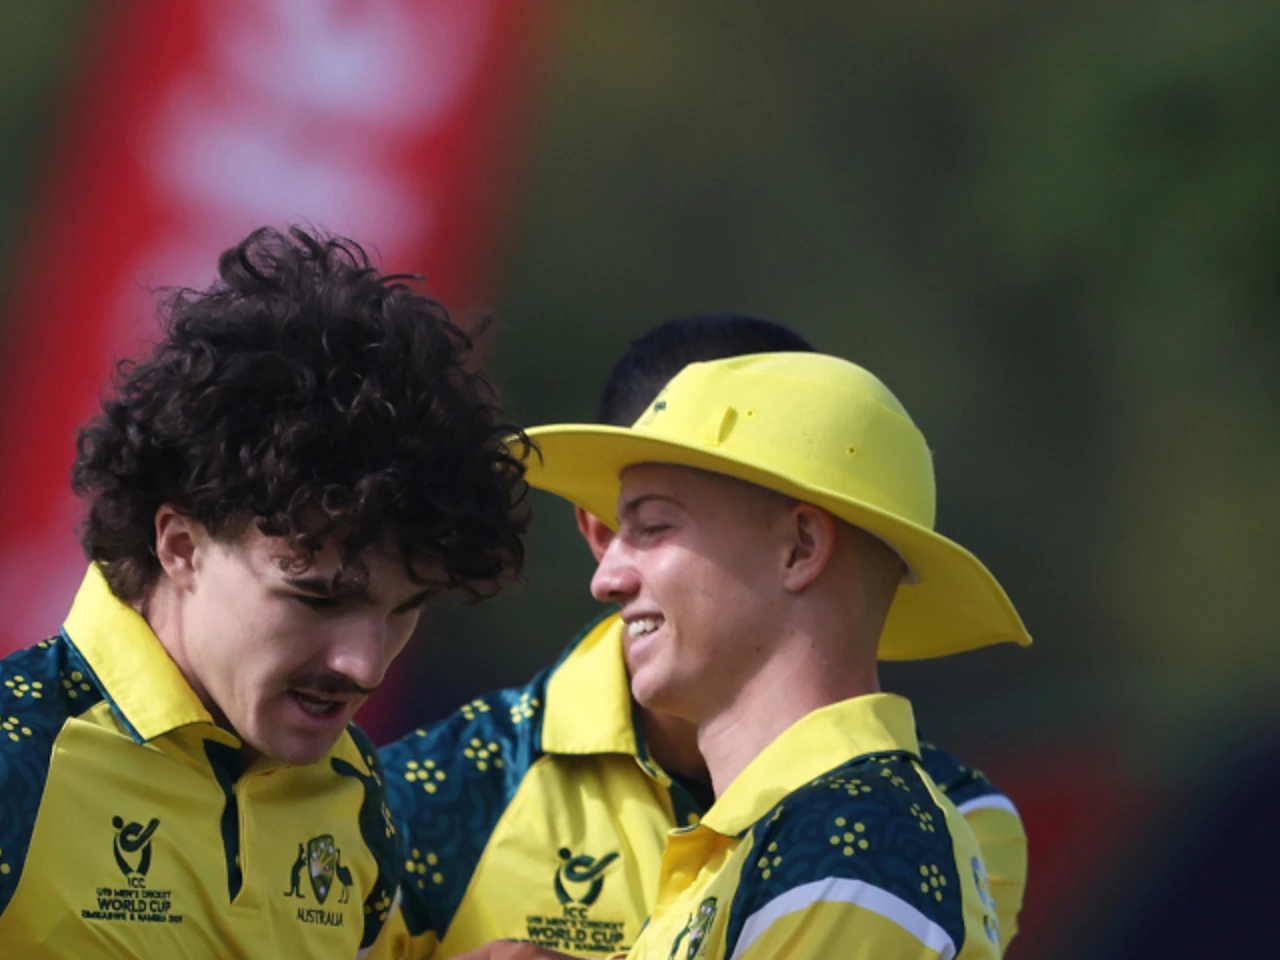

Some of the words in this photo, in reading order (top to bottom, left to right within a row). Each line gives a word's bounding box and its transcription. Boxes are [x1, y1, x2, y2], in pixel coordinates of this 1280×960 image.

[127, 877, 146, 889] ICC
[97, 898, 146, 912] WORLD
[149, 900, 171, 913] CUP
[563, 906, 589, 920] ICC
[297, 907, 344, 927] AUSTRALIA
[527, 926, 587, 942] WORLD
[591, 930, 624, 945] CUP
